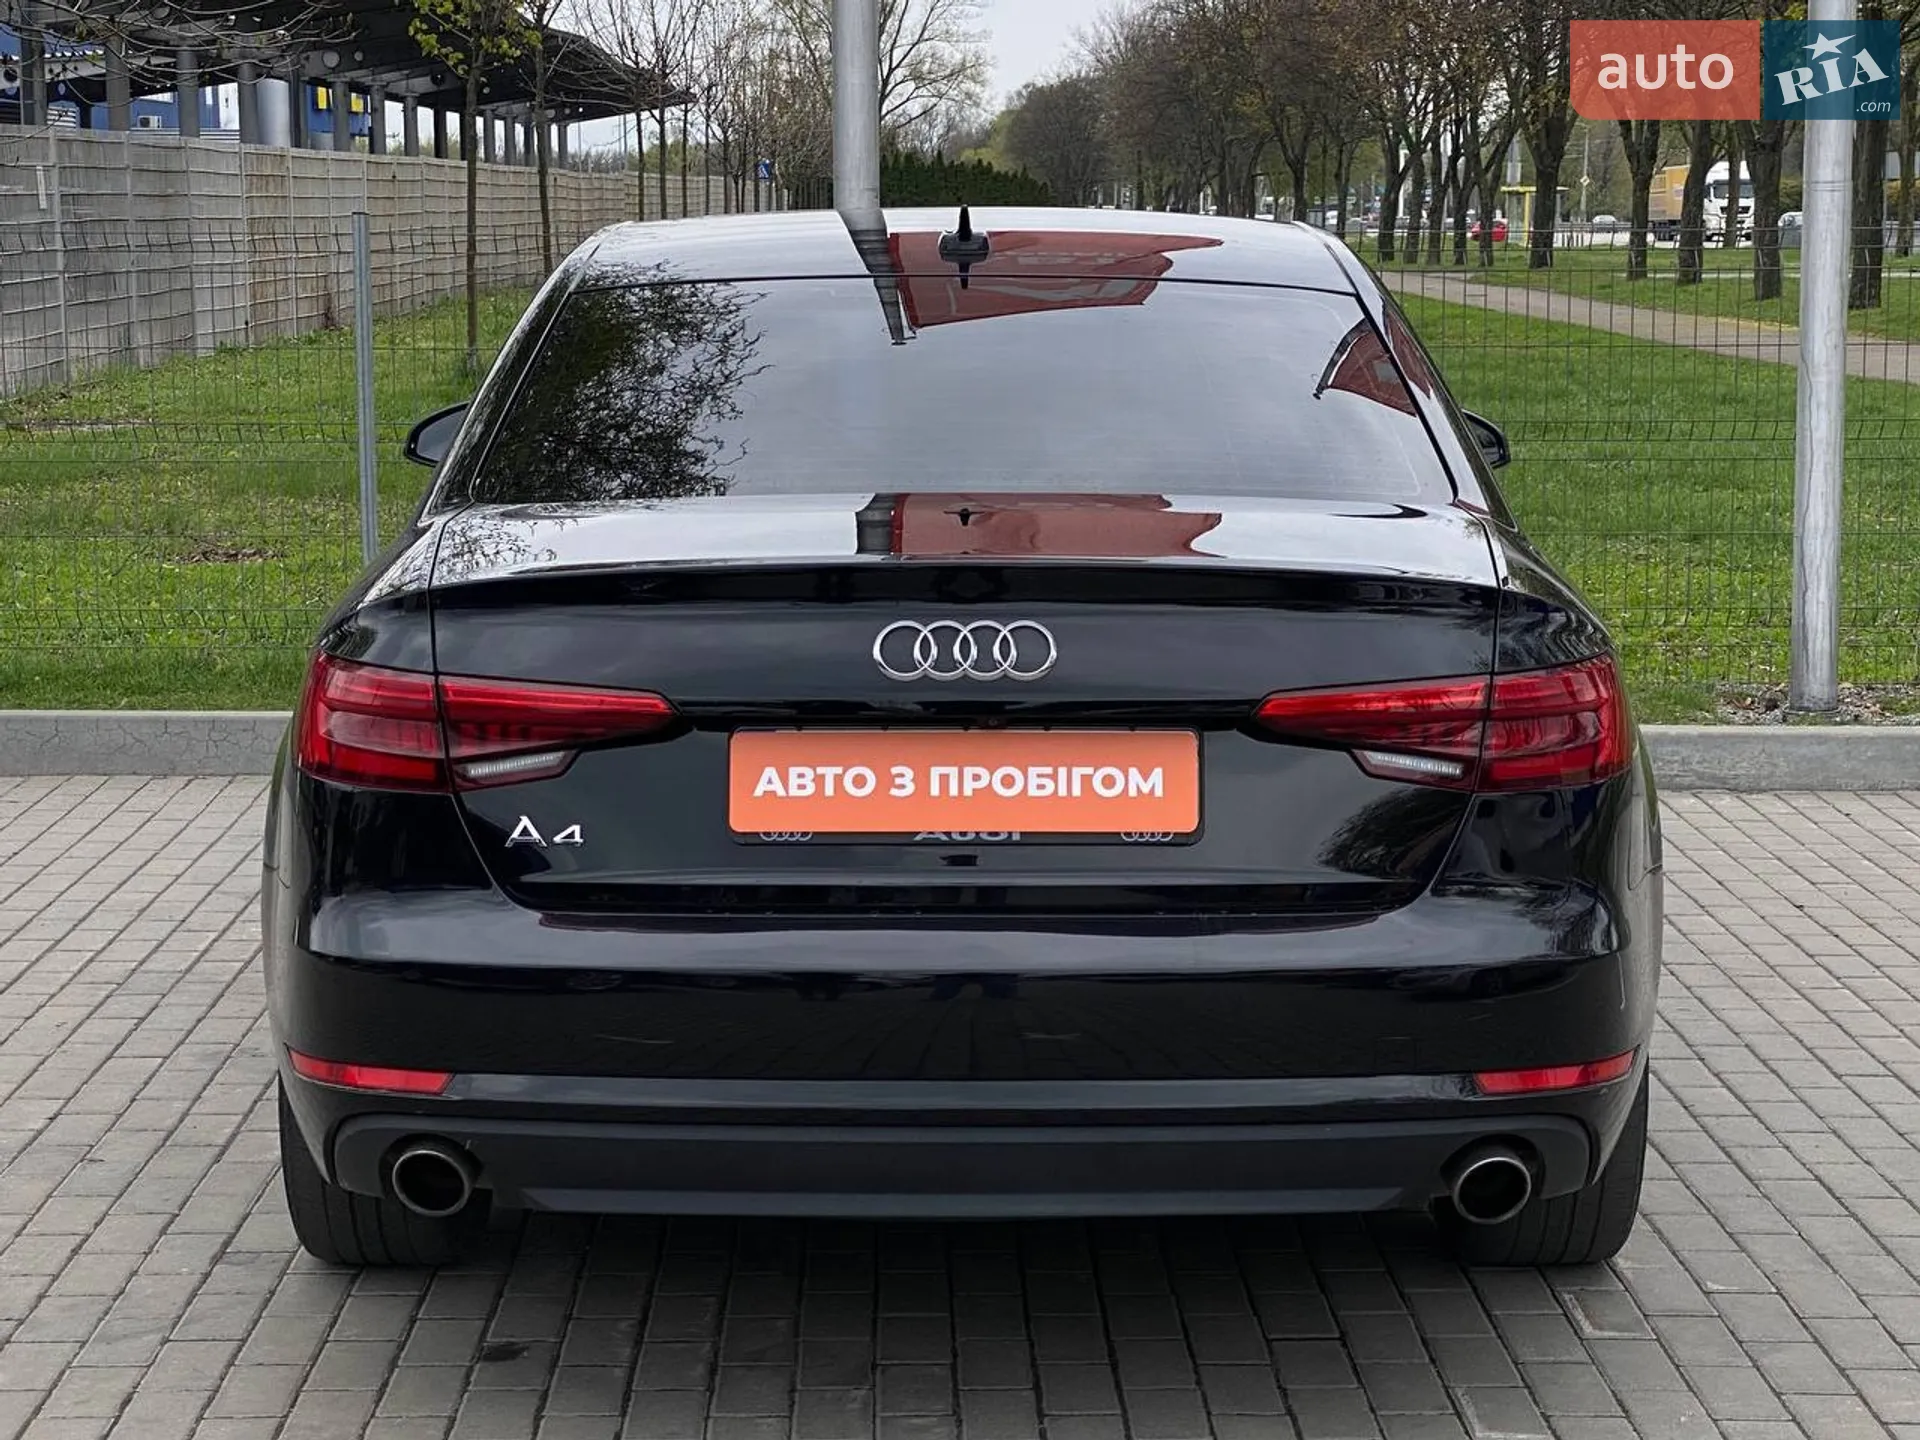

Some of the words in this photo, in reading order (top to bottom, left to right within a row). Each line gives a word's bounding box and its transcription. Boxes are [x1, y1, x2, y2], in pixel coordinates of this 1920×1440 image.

[753, 766, 877, 798] АВТО
[889, 766, 915, 798] З
[930, 766, 1163, 798] ПРОБІГОМ
[504, 815, 584, 848] A4
